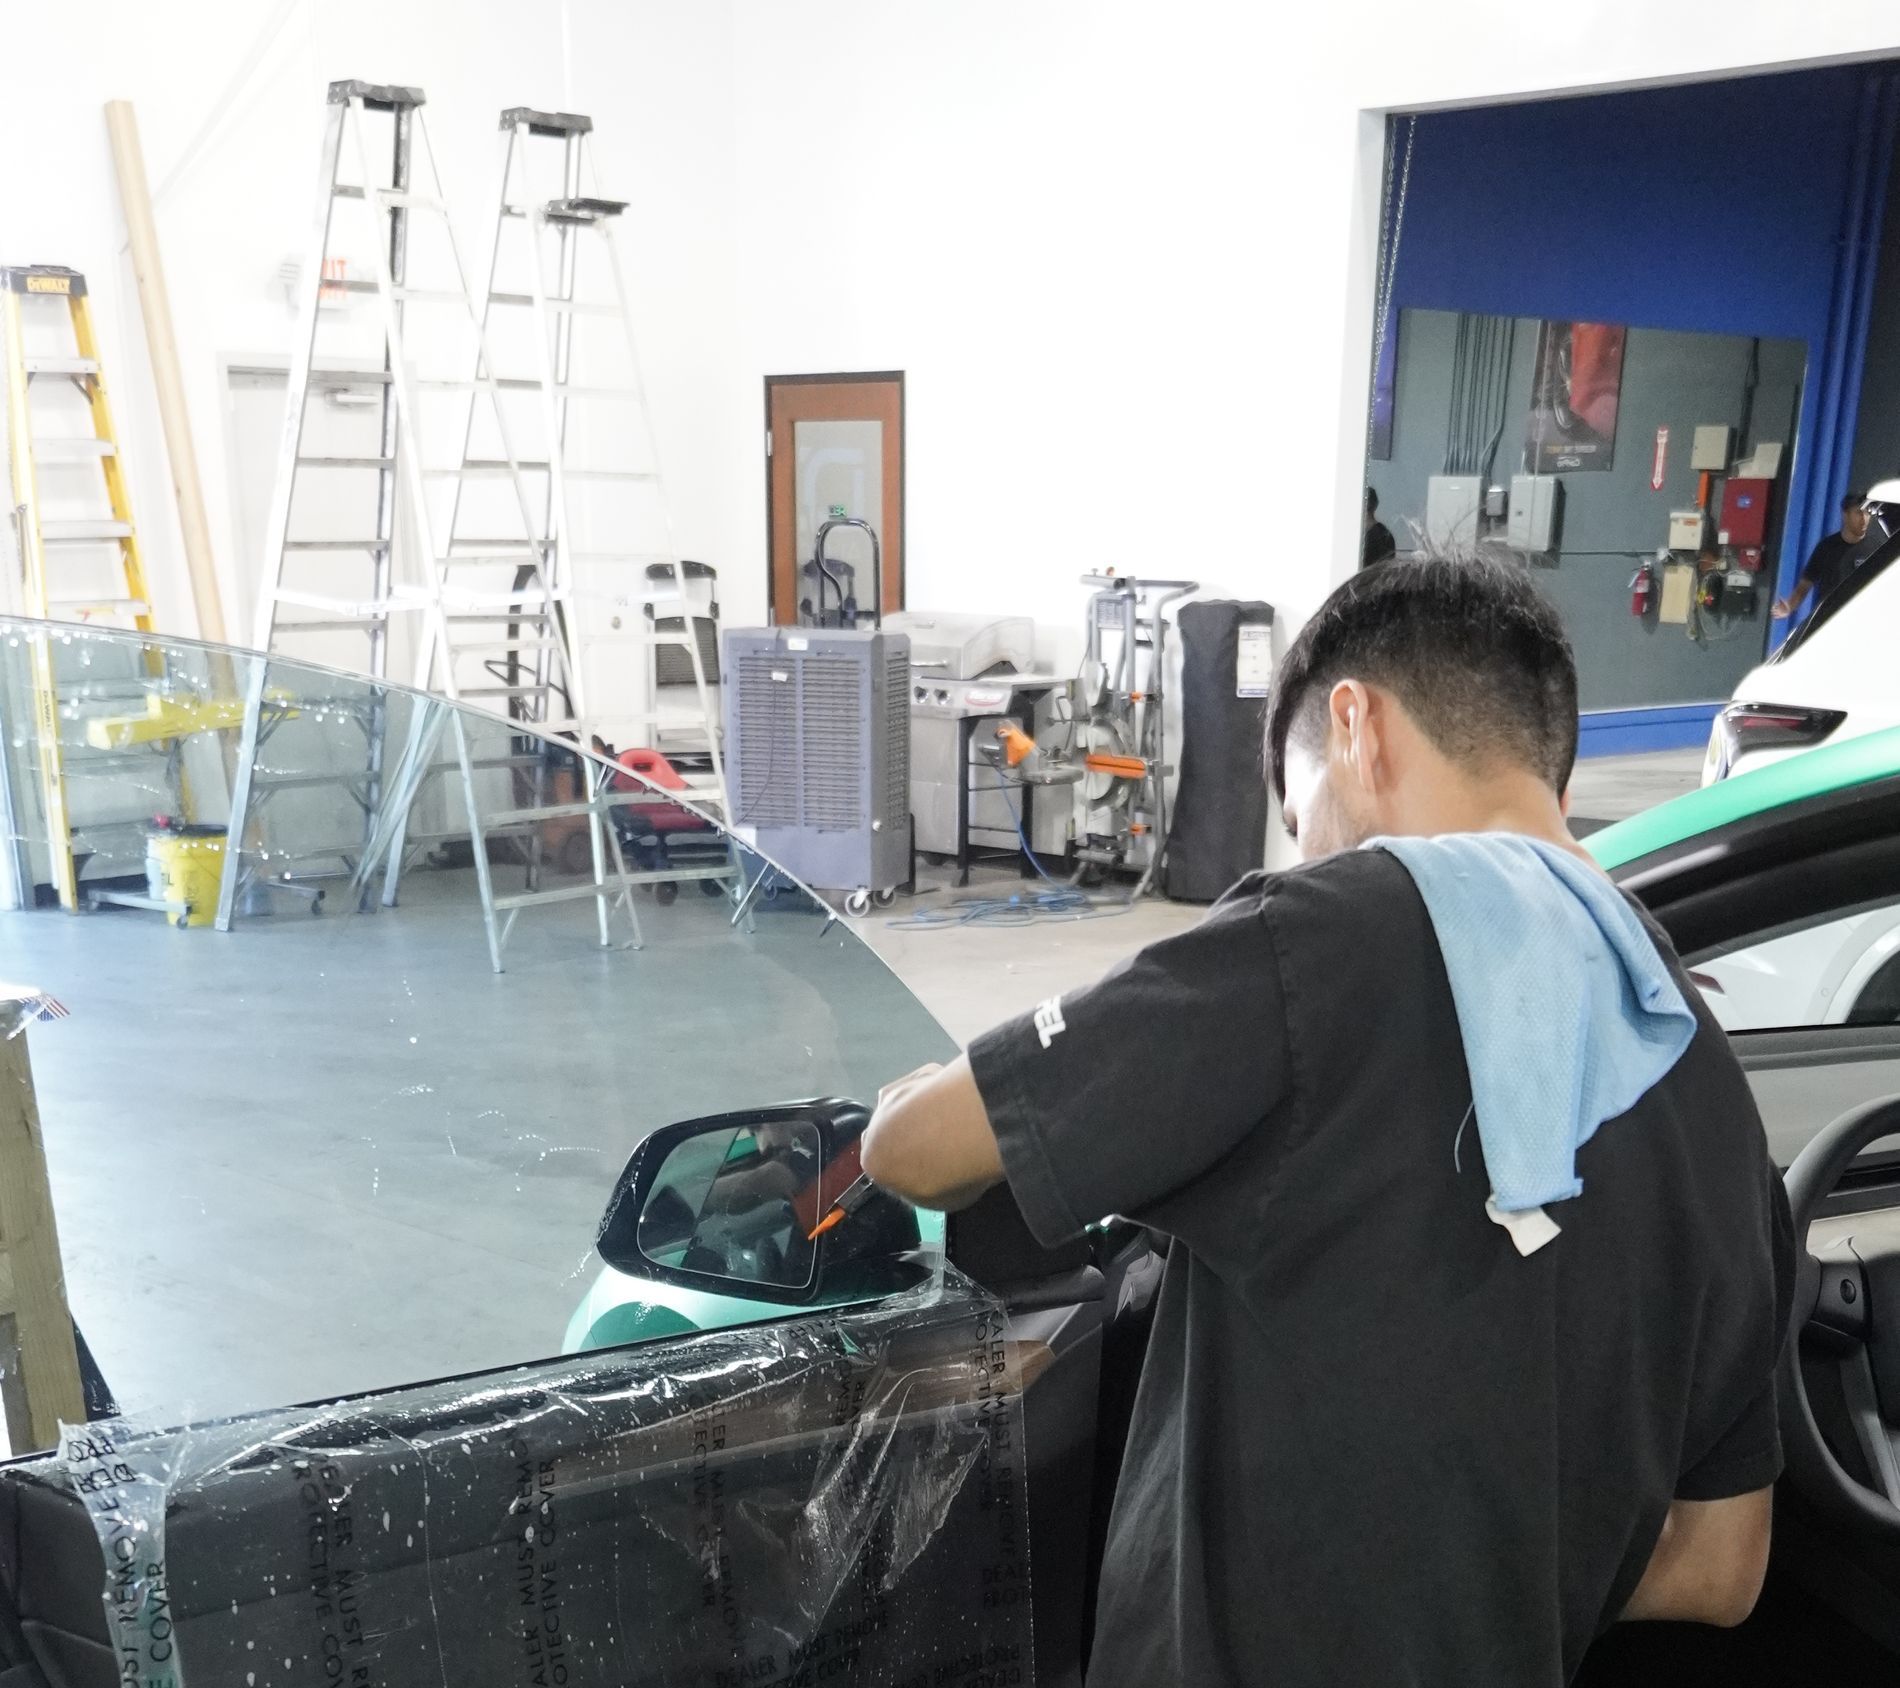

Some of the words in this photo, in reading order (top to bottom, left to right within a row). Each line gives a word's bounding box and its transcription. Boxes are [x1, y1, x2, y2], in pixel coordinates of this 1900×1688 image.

[510, 1437, 534, 1516] REMO
[538, 1454, 562, 1548] COVER
[100, 1497, 138, 1624] REMOVE
[294, 1465, 333, 1621] ROTECTIVE
[518, 1535, 536, 1606] MUST
[147, 1561, 173, 1662] COVER
[334, 1569, 364, 1646] MUST
